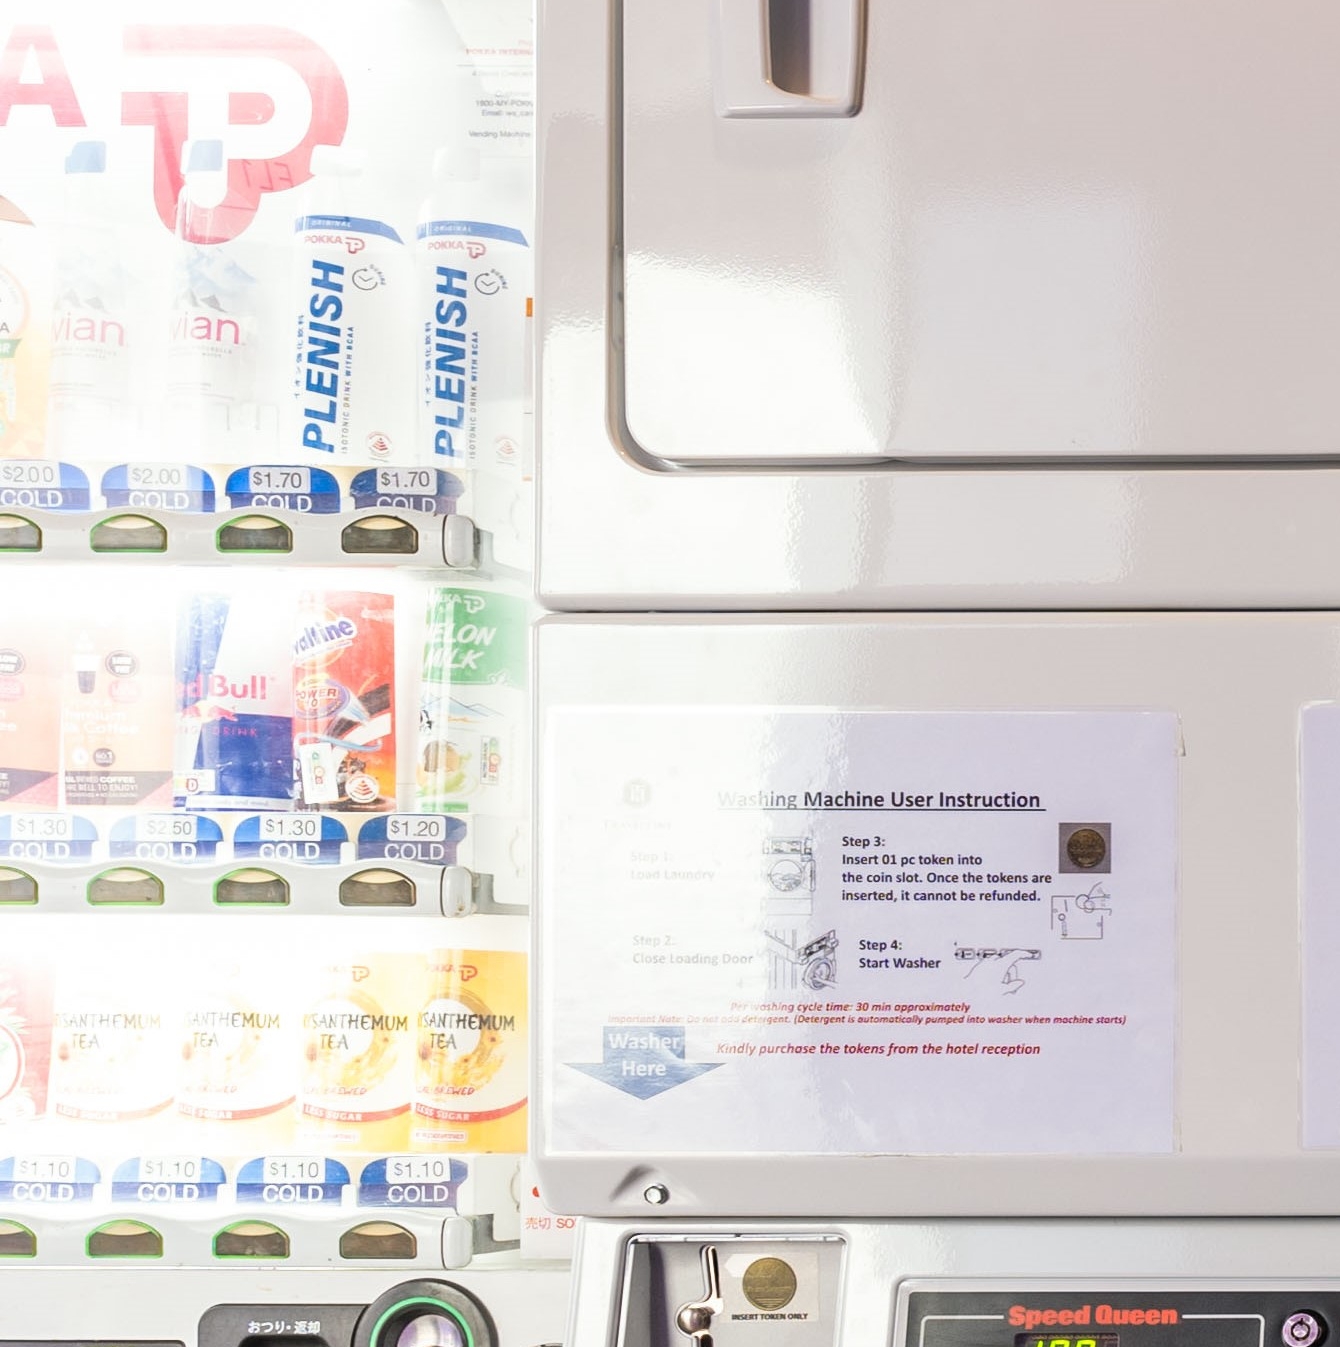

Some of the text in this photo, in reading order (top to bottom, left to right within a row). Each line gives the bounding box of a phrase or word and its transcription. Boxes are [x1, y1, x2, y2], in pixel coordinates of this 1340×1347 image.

[303, 260, 344, 452] PLENISH
[434, 266, 468, 457] PLENISH
[253, 472, 302, 489] $1.70
[381, 470, 430, 488] $1.70
[209, 674, 267, 700] Bull
[804, 790, 1040, 808] Machine User Instruction
[16, 817, 68, 839] $1.30
[147, 817, 193, 839] $2.50
[265, 817, 317, 839] $1.30
[387, 817, 440, 839] $1.20
[259, 842, 321, 863] COLD
[383, 842, 445, 863] COLD
[321, 1032, 350, 1051] TEA
[430, 1032, 458, 1051] TEA
[609, 1034, 681, 1052] Washer
[622, 1061, 666, 1078] Here
[269, 1159, 320, 1180] $1.10
[392, 1159, 444, 1180] $1.10
[262, 1183, 325, 1205] COLD
[387, 1183, 449, 1205] COLD
[1008, 1306, 1178, 1328] Speed Queen
